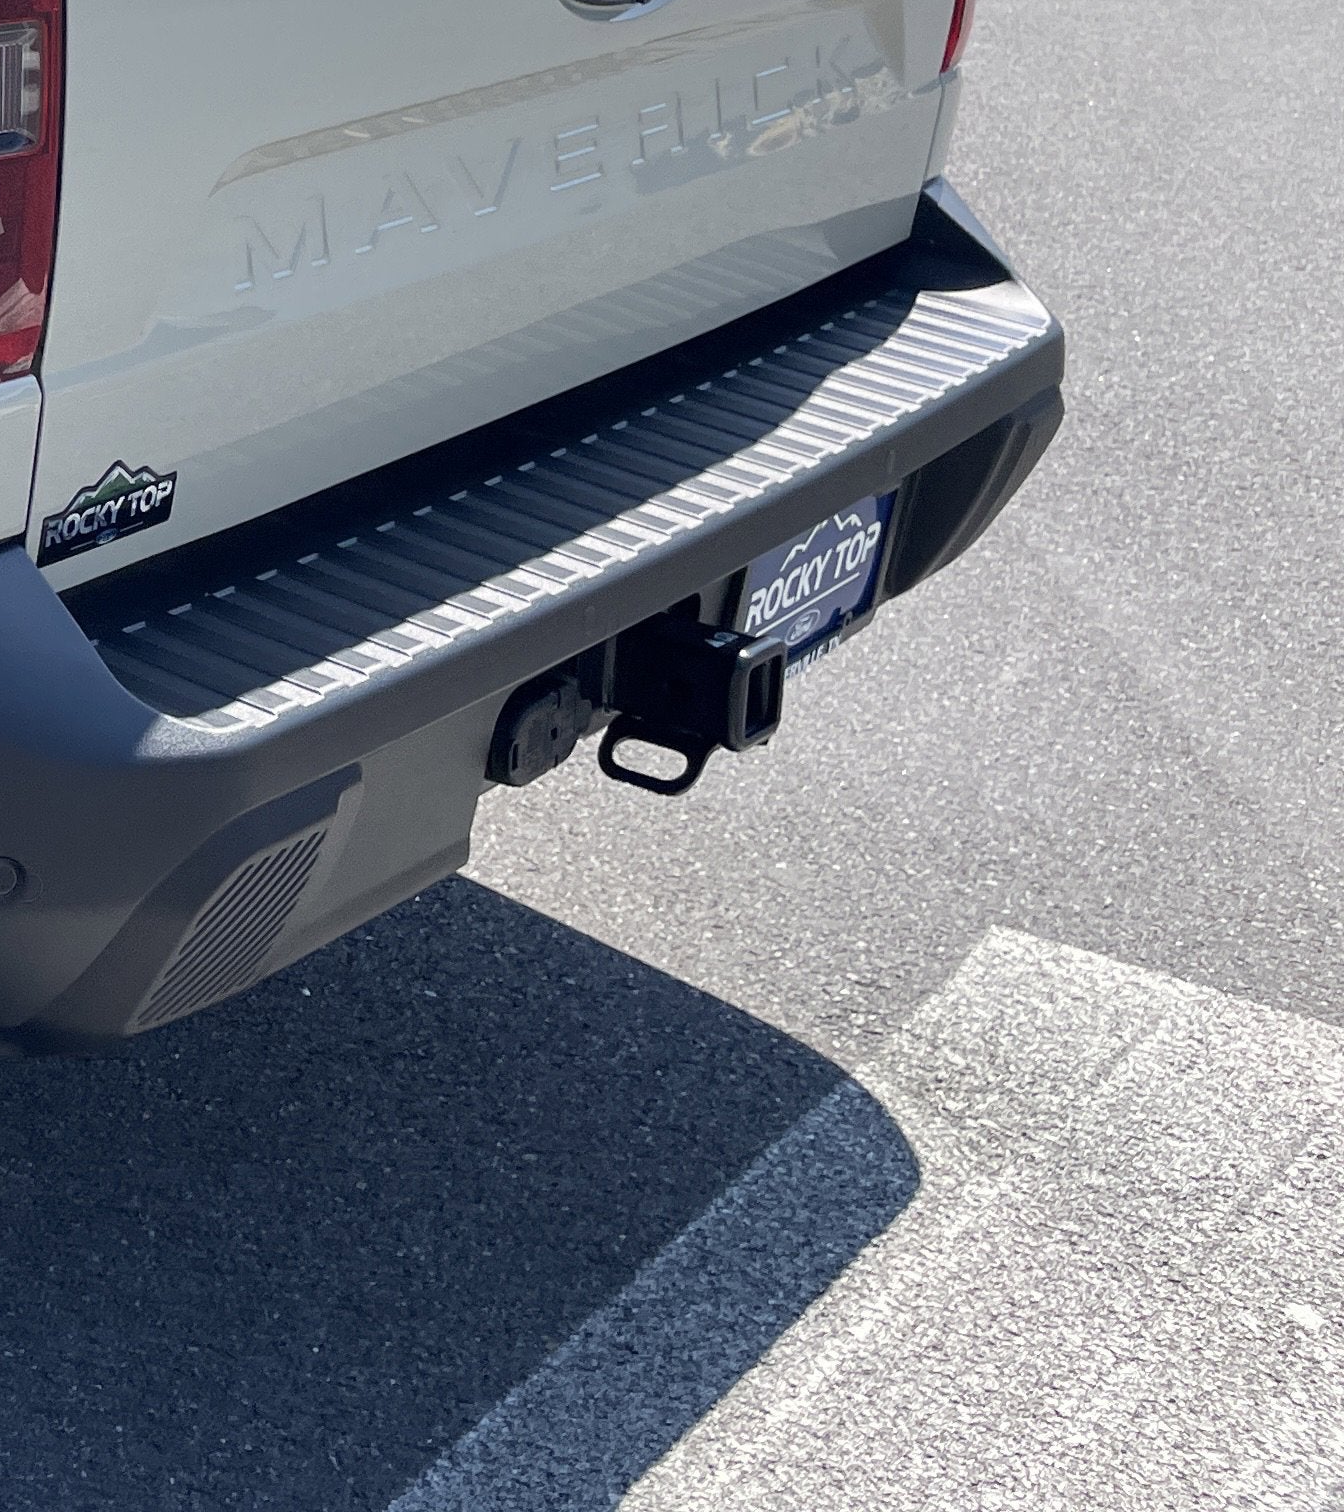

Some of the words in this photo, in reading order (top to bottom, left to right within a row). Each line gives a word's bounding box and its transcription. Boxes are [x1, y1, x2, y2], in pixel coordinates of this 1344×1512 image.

[233, 32, 864, 292] MAVERICK
[44, 495, 125, 548] ROCKY
[127, 479, 173, 517] TOP
[744, 548, 833, 633] ROCKY
[833, 521, 881, 579] TOP
